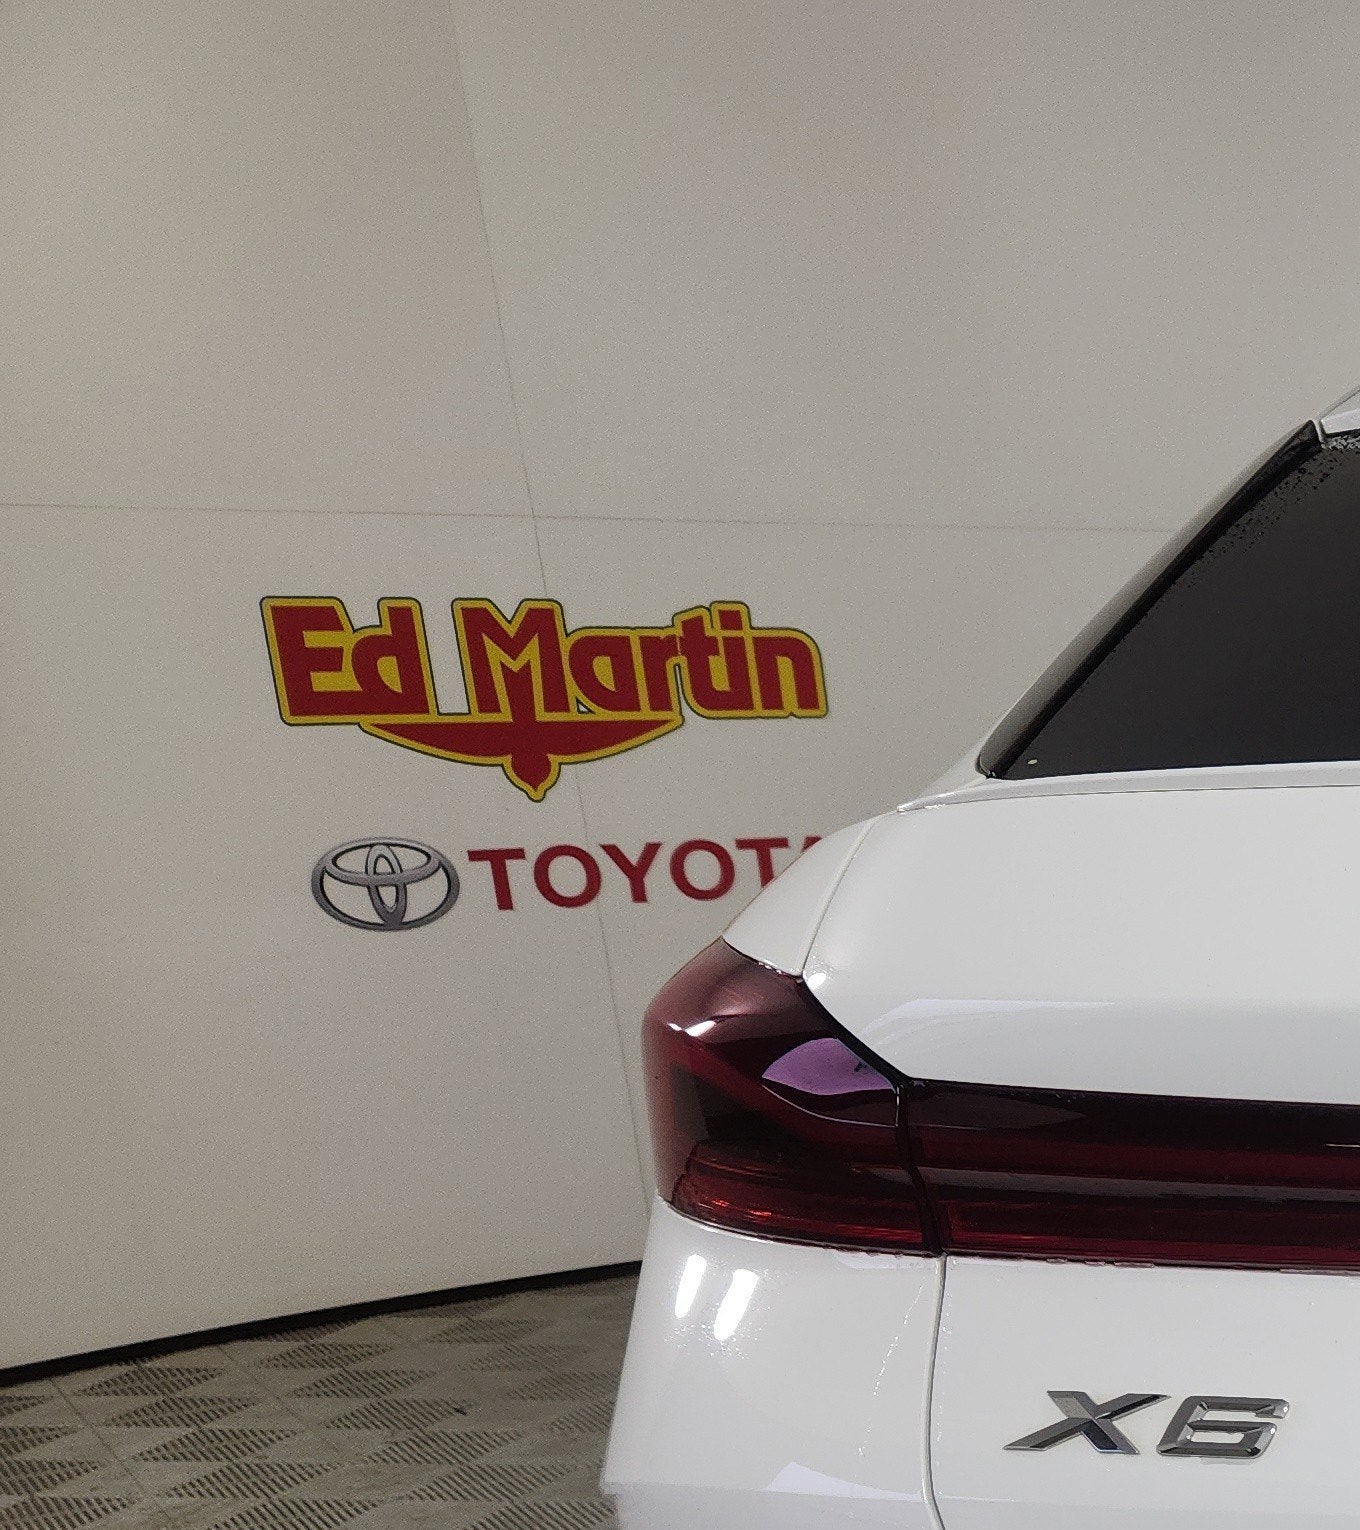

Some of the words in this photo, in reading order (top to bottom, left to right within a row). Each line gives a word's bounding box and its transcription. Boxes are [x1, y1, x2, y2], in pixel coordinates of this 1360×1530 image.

[261, 597, 438, 725] Ed
[452, 598, 829, 722] Martin
[468, 836, 823, 911] TOYOT
[1002, 1390, 1290, 1459] X6
